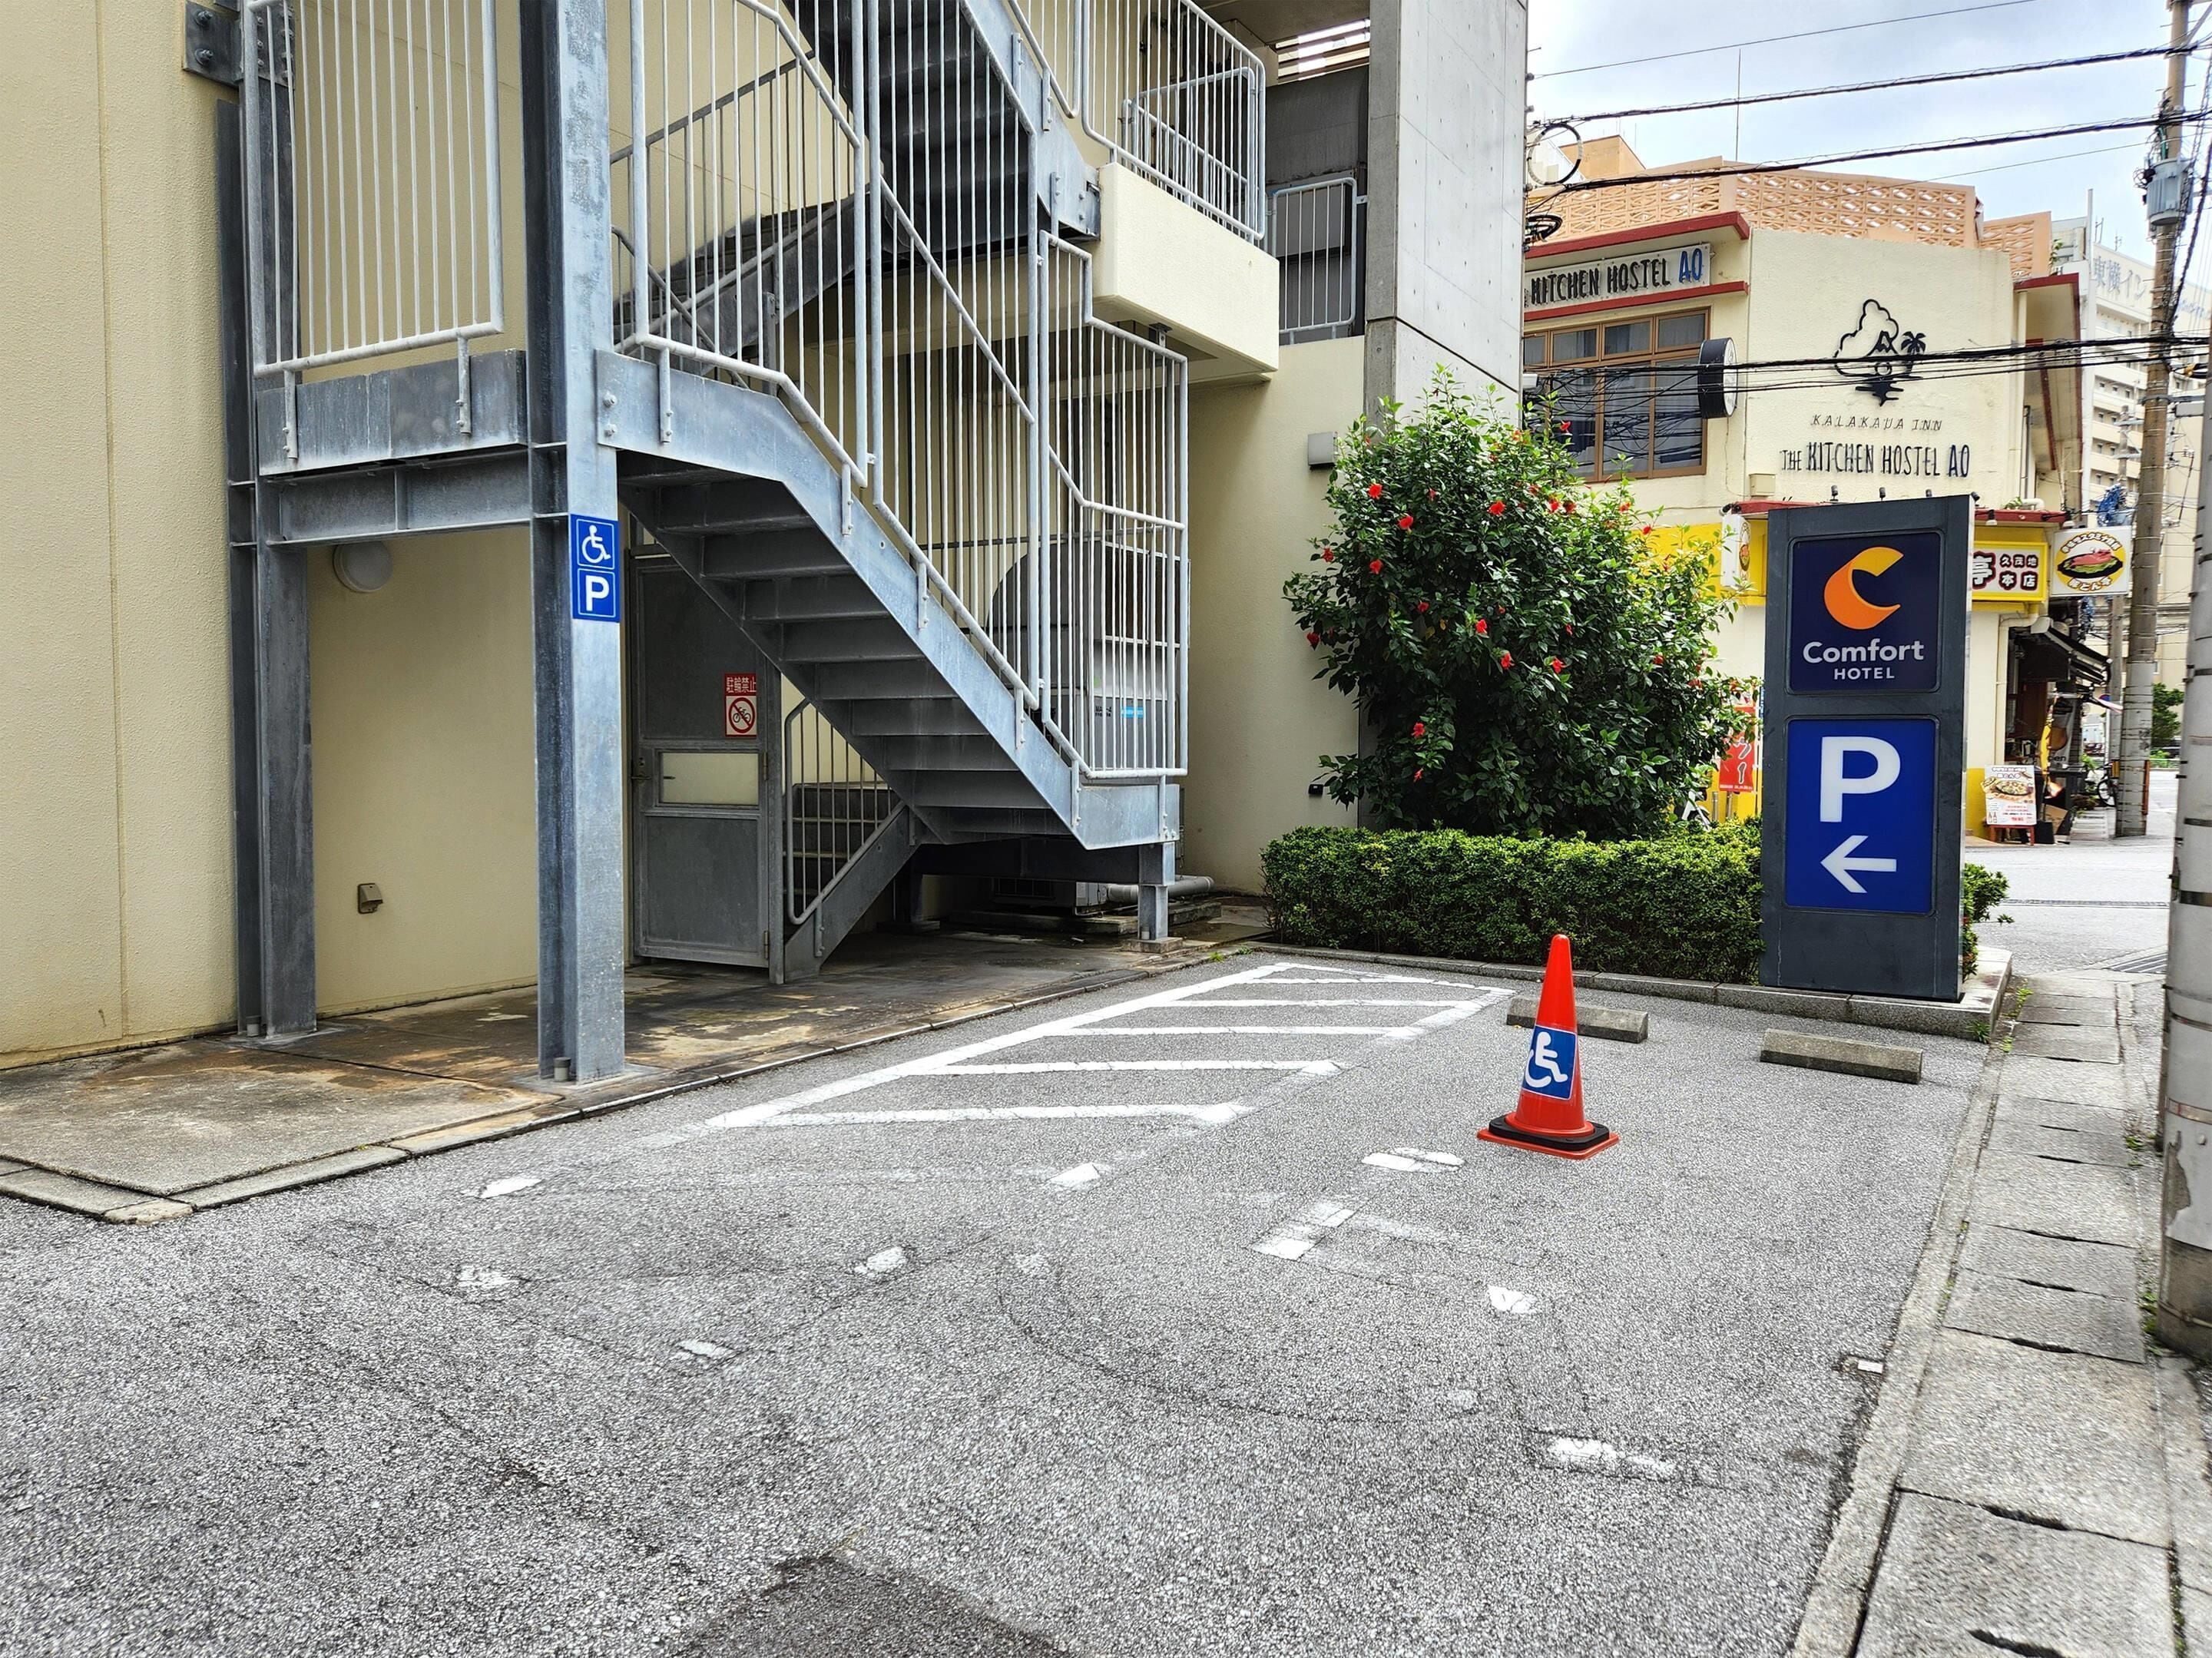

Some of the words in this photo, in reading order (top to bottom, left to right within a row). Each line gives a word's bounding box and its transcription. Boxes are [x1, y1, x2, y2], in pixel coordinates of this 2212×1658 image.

[1531, 267, 1600, 305] KITCHEN
[1607, 257, 1671, 293] HOSTEL
[1678, 248, 1703, 283] AO
[1810, 414, 1905, 430] KALAKAUA
[1911, 419, 1942, 431] INN
[1780, 449, 1802, 471] THE
[1806, 442, 1874, 474] KITCHEN
[1882, 445, 1940, 476] HOSTEL
[1947, 444, 1970, 478] AO
[2000, 555, 2038, 567] 久茂地
[585, 574, 610, 611] P
[2000, 573, 2037, 587] 本店
[1803, 638, 1924, 664] Comfort
[1834, 667, 1895, 680] HOTEL
[1820, 736, 1901, 822] P
